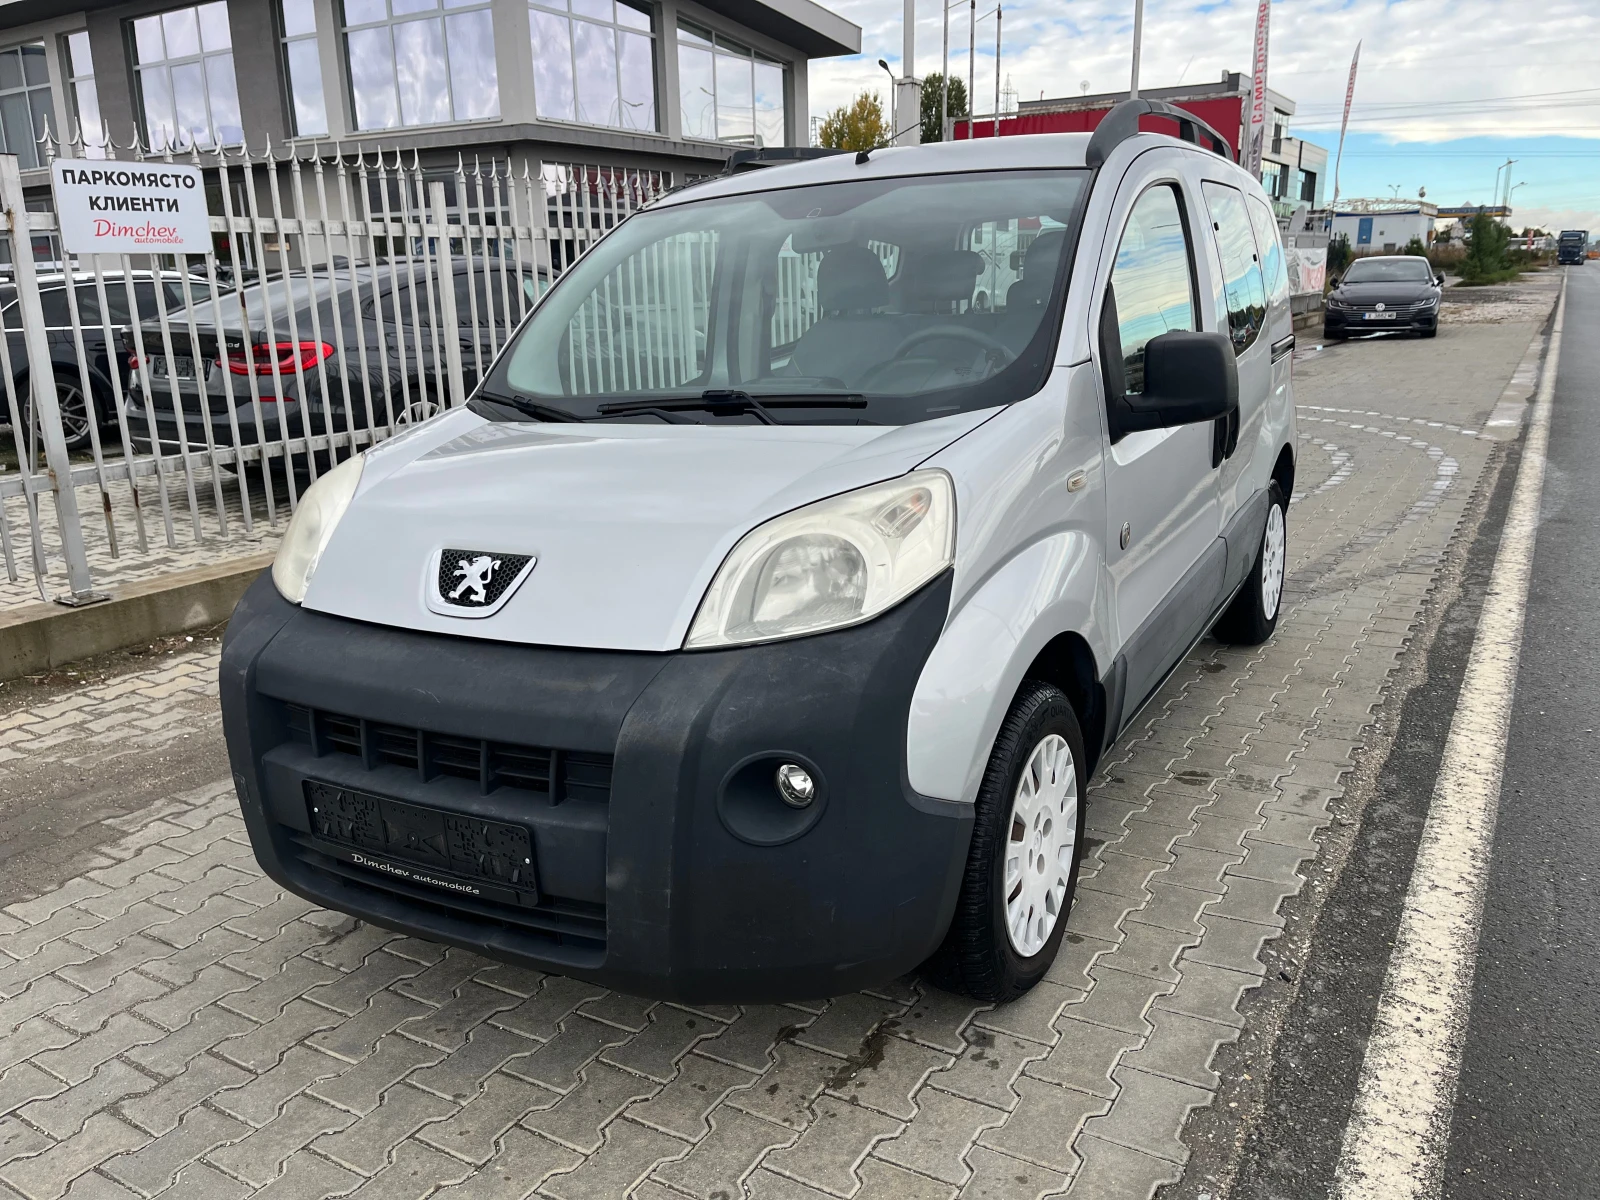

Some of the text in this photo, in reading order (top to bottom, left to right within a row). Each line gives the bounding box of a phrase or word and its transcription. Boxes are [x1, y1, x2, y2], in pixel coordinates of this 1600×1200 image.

[62, 169, 196, 189] ПАРКОМЯСТО
[88, 195, 180, 213] КЛИЕНТИ
[93, 219, 177, 238] Dimchev
[134, 236, 184, 244] automobile
[351, 854, 480, 895] Dimchev automobile
